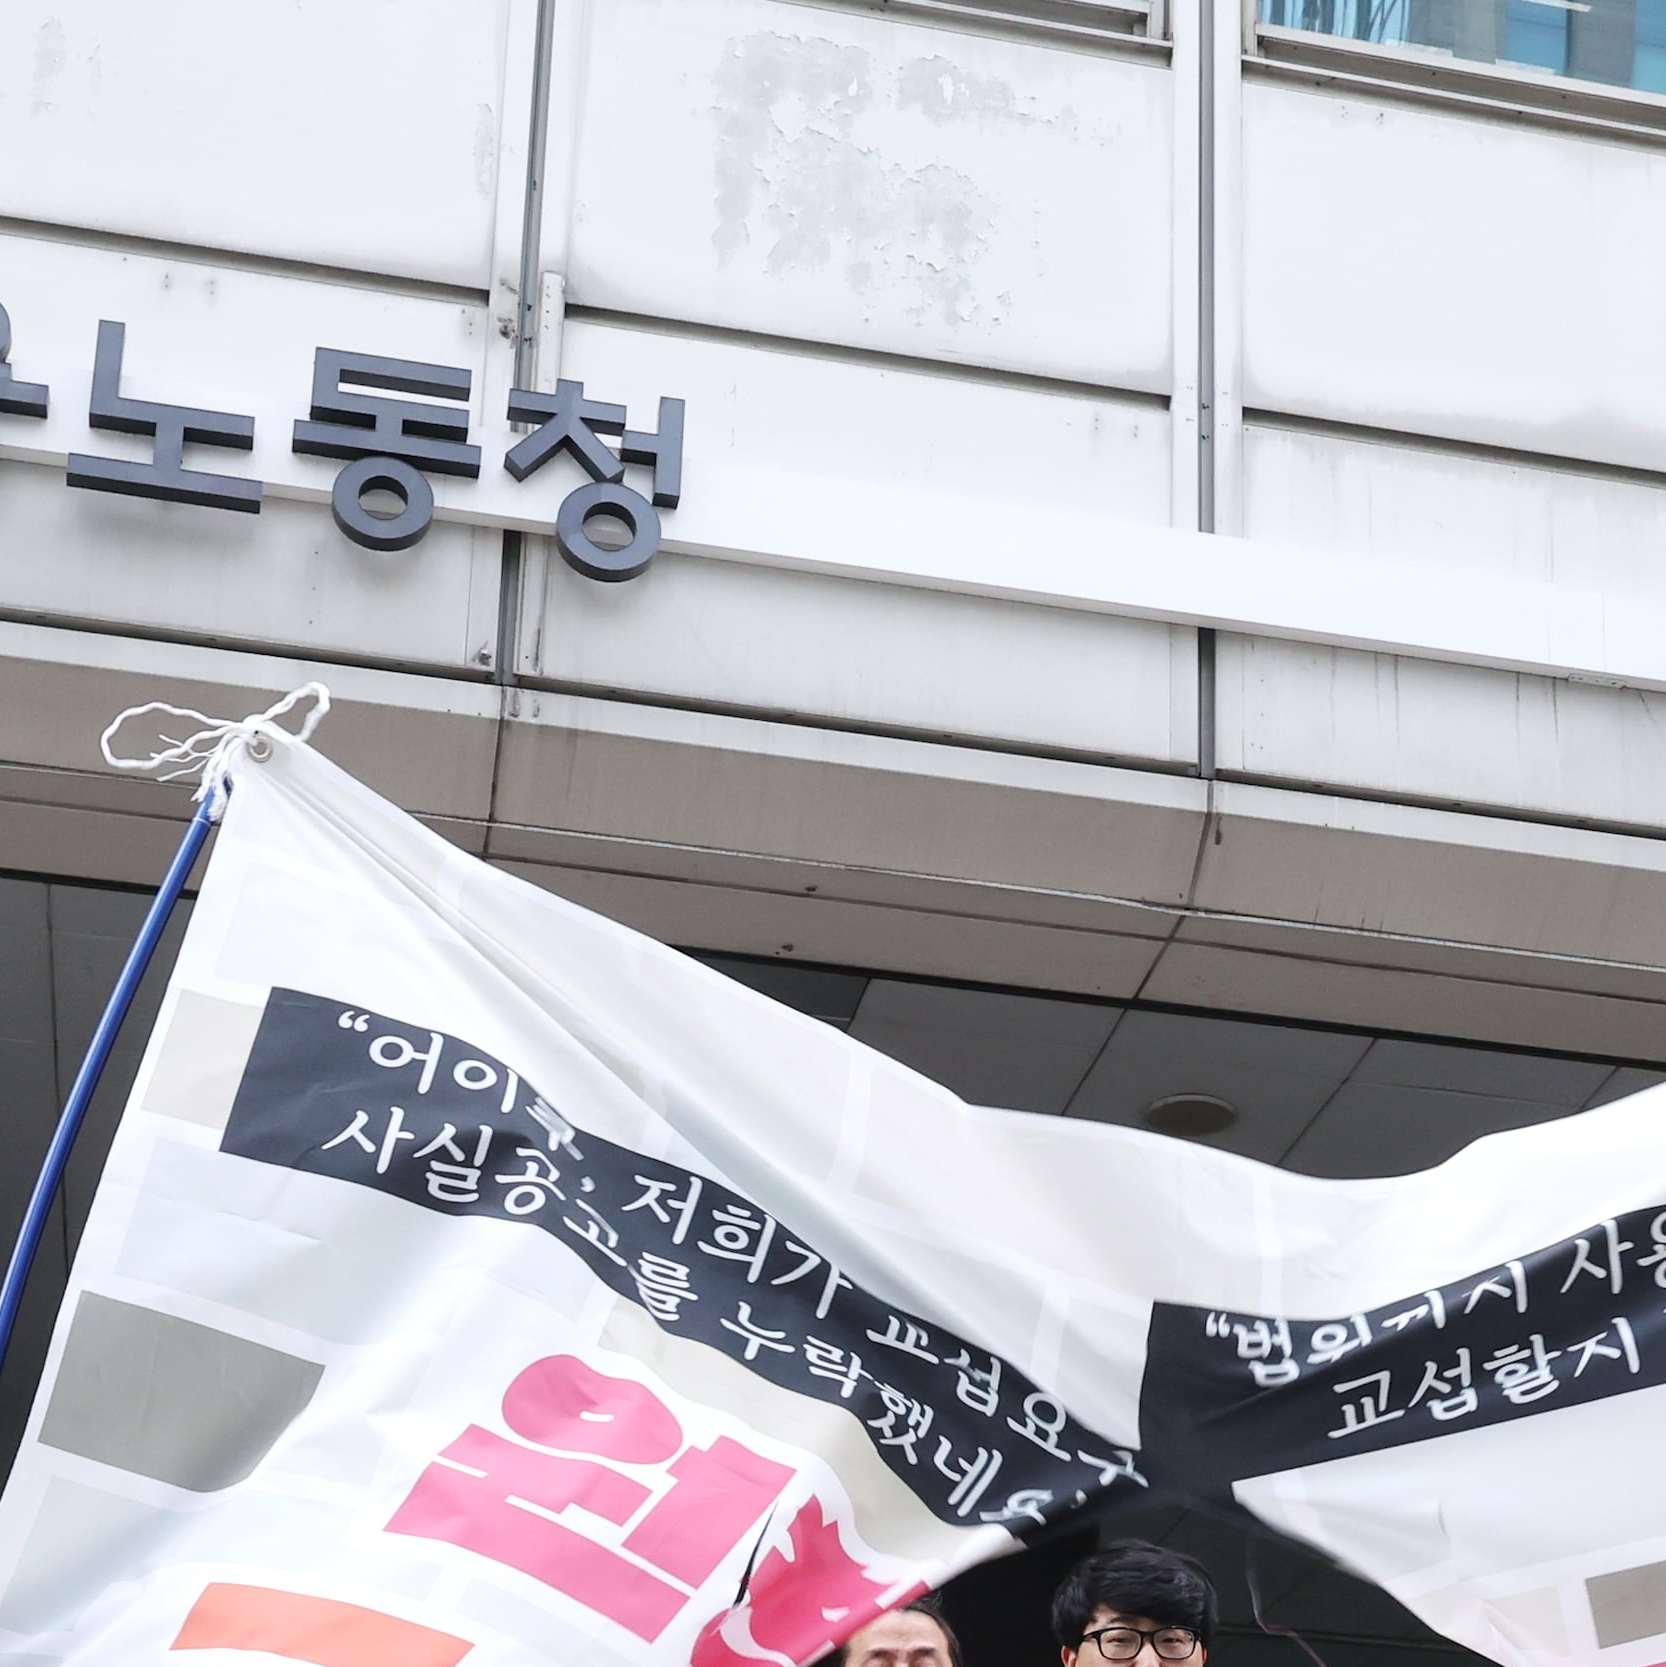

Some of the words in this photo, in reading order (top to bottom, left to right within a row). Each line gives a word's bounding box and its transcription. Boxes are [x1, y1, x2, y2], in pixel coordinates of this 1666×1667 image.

[320, 1105, 700, 1322] 사실공고를
[620, 1173, 854, 1320] 저희가
[1326, 1316, 1641, 1440] 교섭할지
